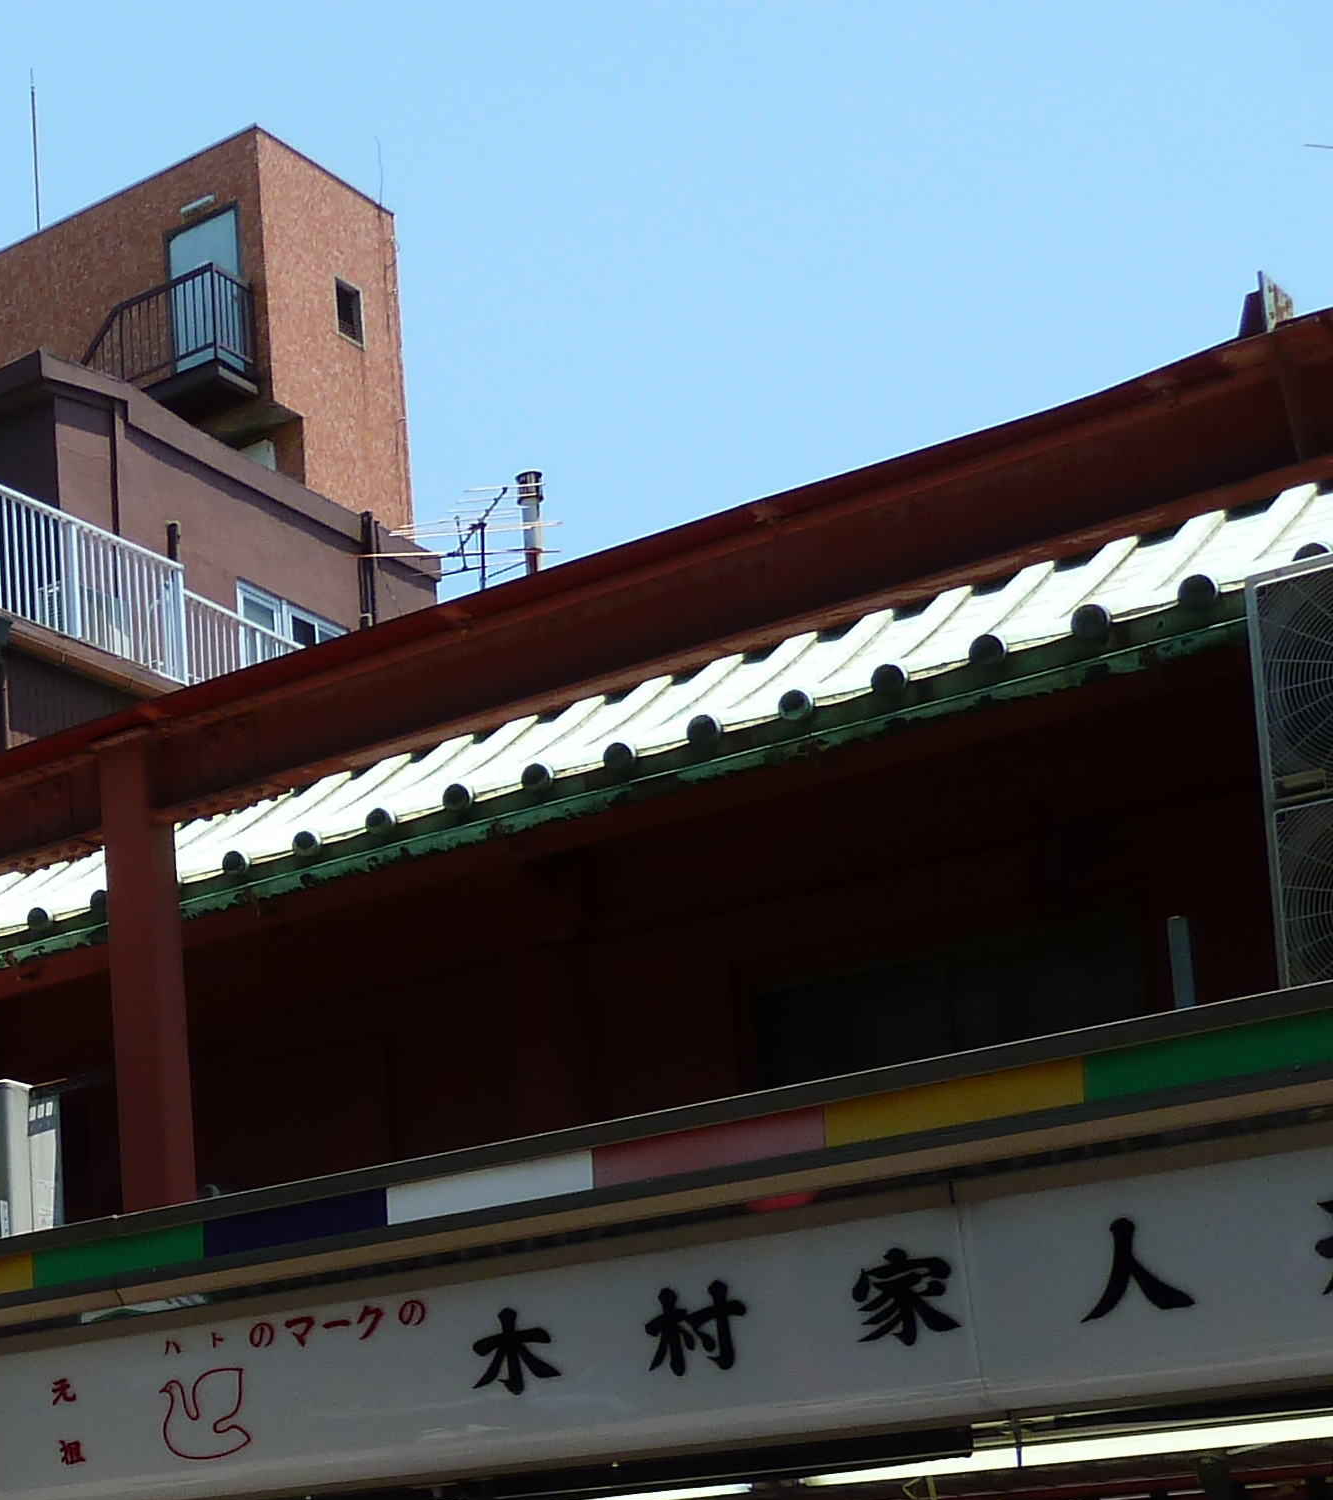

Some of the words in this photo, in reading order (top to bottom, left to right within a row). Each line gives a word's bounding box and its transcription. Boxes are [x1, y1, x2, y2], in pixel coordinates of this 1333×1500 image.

[163, 1298, 426, 1355] ハトのマークの
[472, 1199, 1333, 1396] 木村家人
[51, 1378, 86, 1465] 元祖
